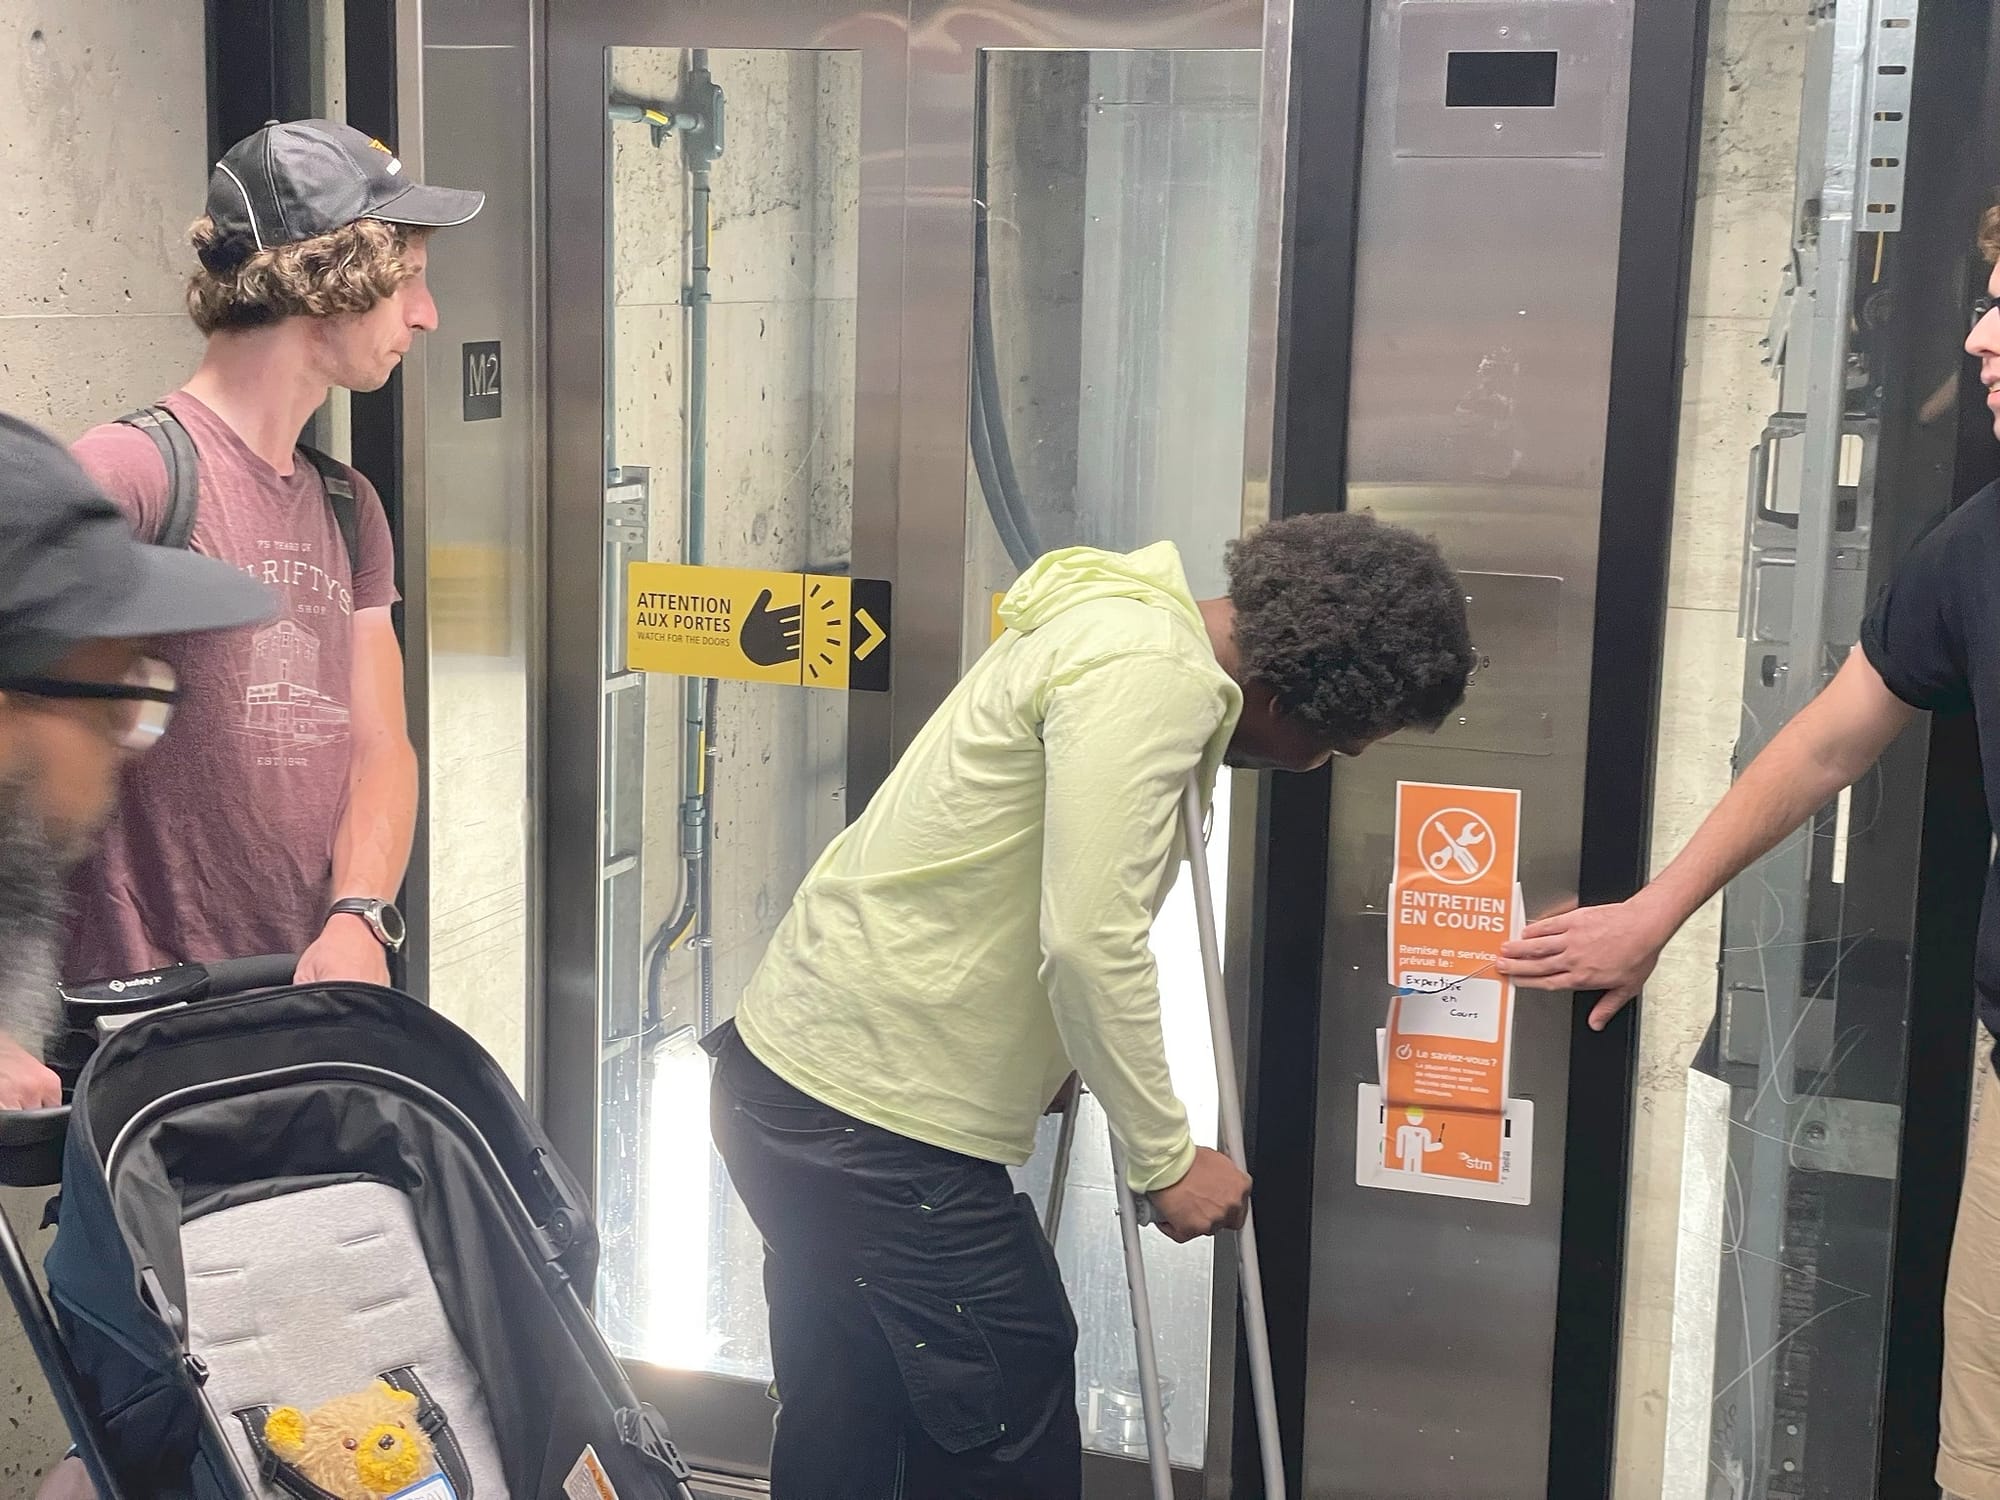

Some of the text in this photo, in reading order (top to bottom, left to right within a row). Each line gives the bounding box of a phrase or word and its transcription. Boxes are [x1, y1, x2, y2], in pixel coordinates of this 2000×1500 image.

[468, 352, 499, 397] M2
[238, 559, 351, 616] RIFTYS
[636, 592, 731, 614] ATTENTION
[636, 611, 731, 633] AUX PORTES
[637, 631, 731, 648] WATCH FOR THE DOORS
[1401, 889, 1505, 914] ENTRETIEN
[1400, 908, 1505, 933] EN COURS
[1399, 944, 1497, 962] Remise en service
[1441, 995, 1457, 1003] en
[1465, 1157, 1492, 1171] stm
